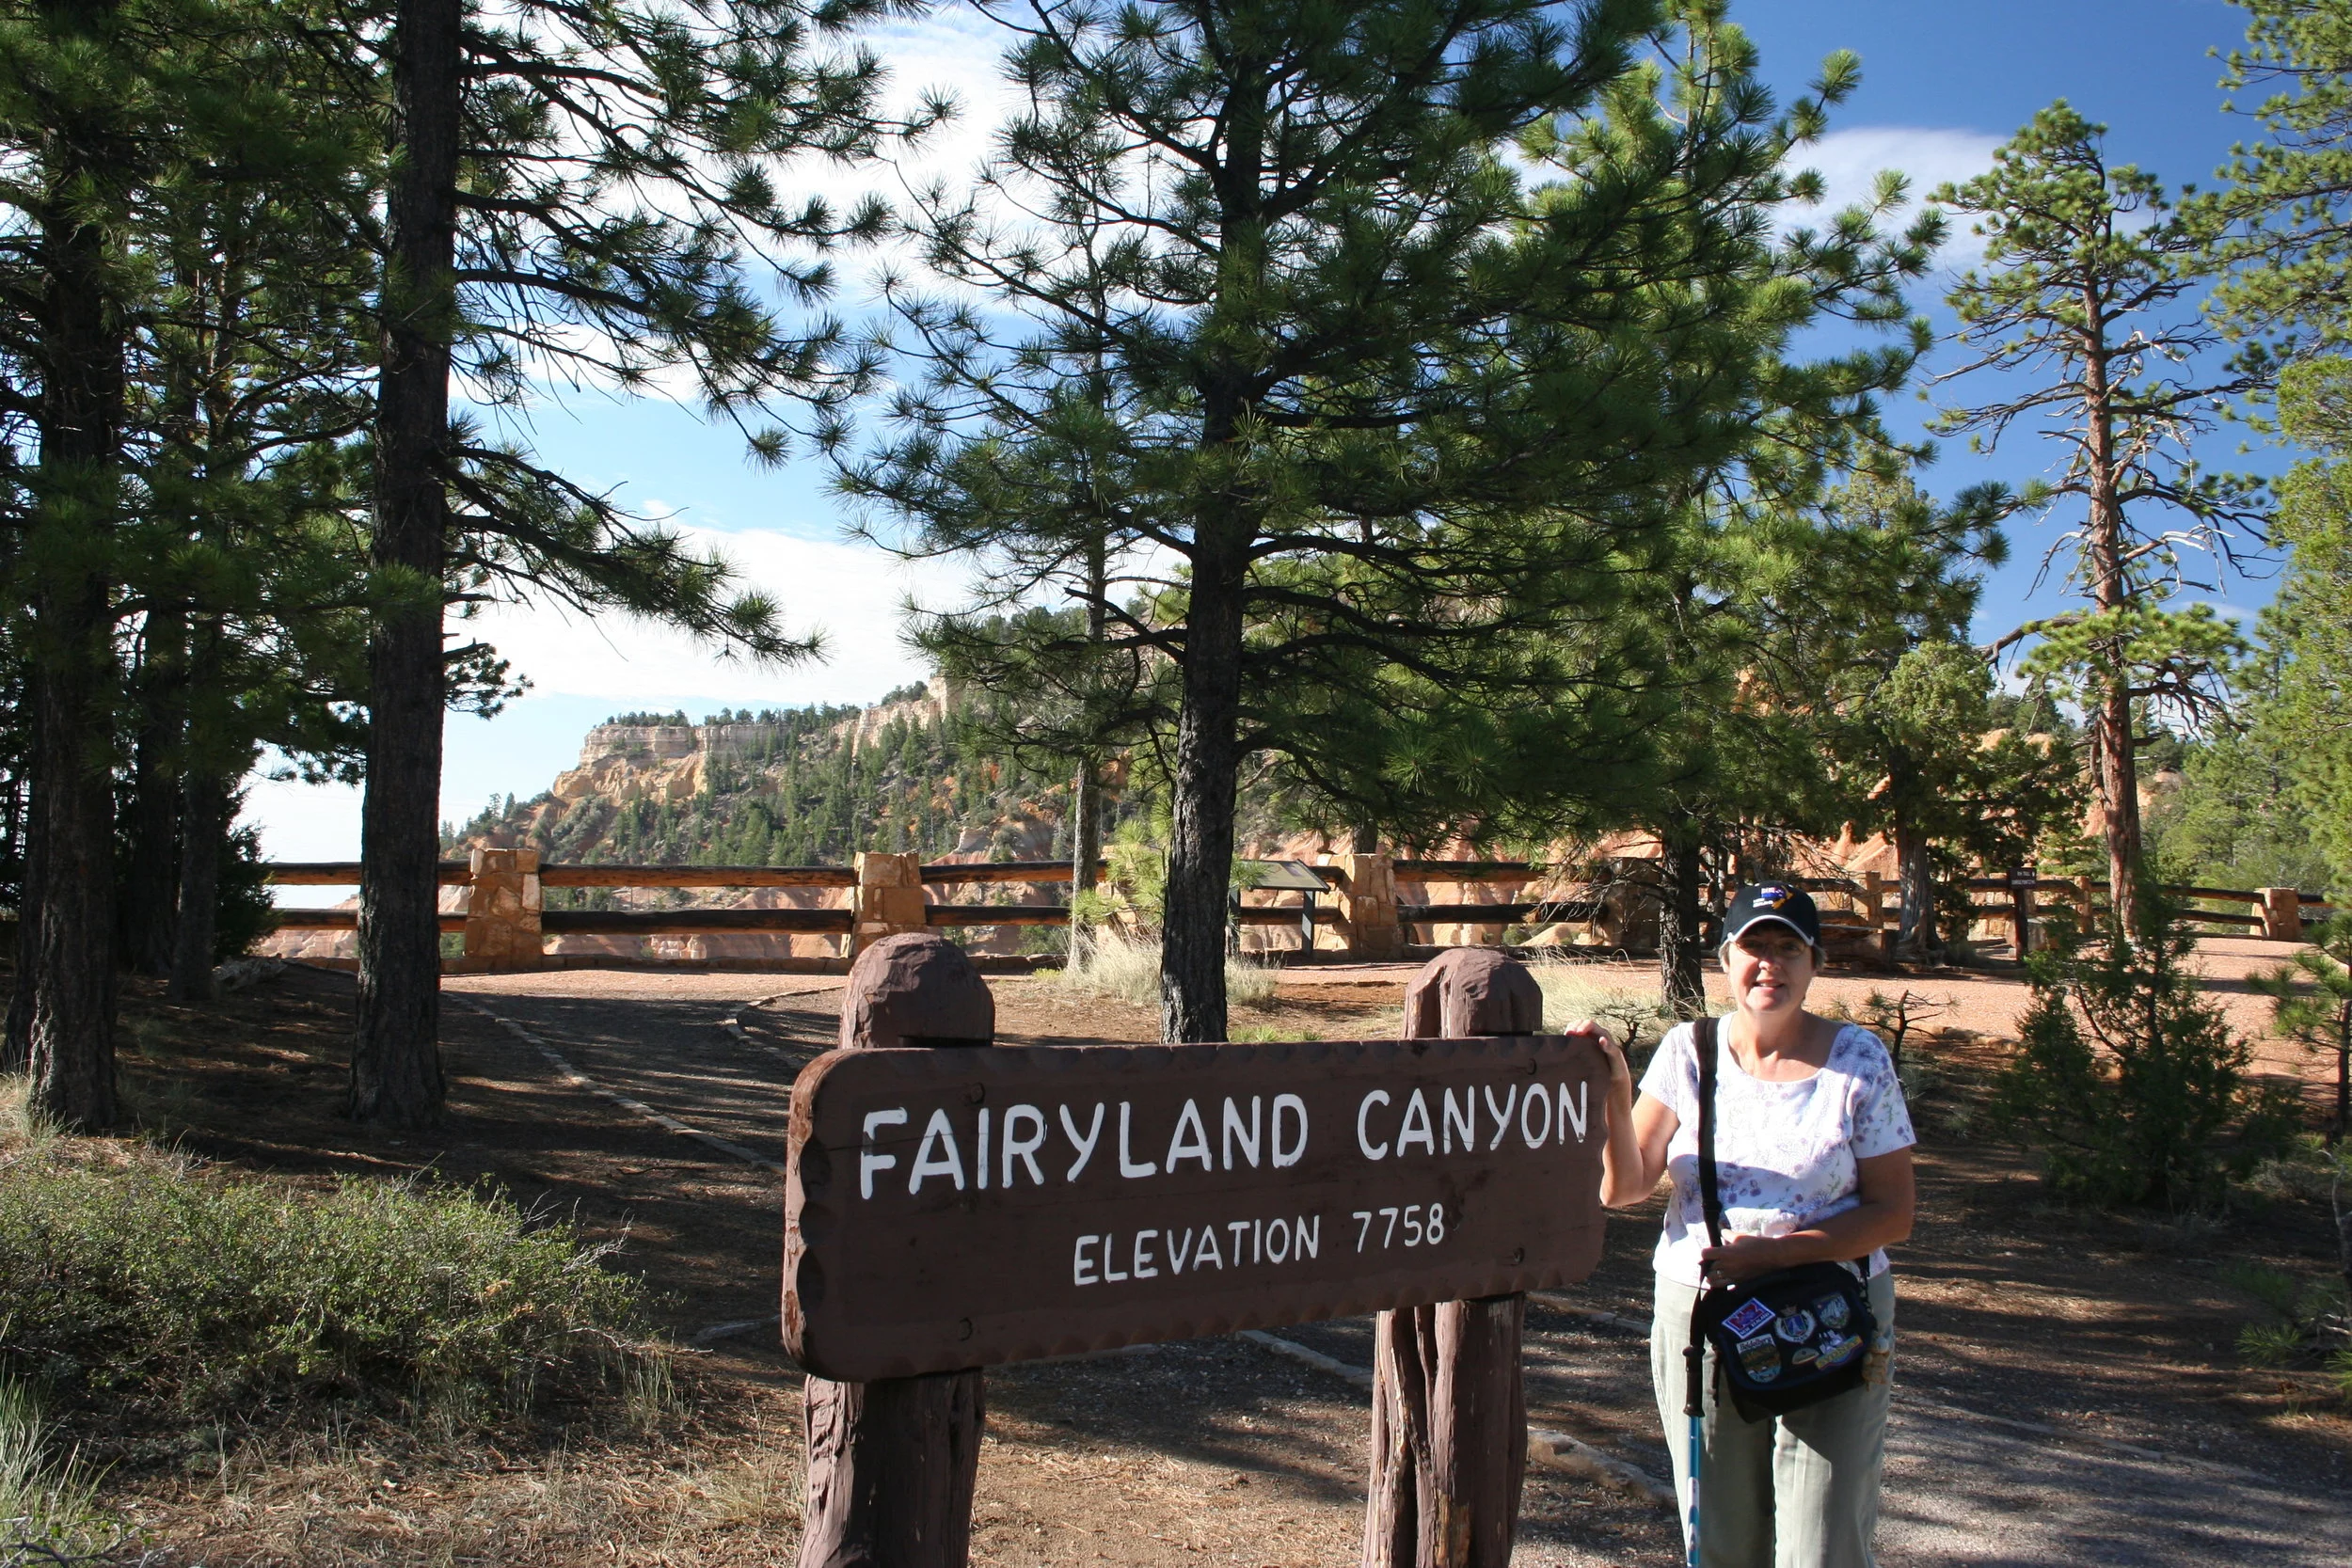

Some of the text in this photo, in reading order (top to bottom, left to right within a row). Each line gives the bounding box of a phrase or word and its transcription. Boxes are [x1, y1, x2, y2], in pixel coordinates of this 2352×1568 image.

[860, 1080, 1588, 1200] FAIRYLAND CANYON
[1073, 1202, 1445, 1287] ELEVATION 7758
